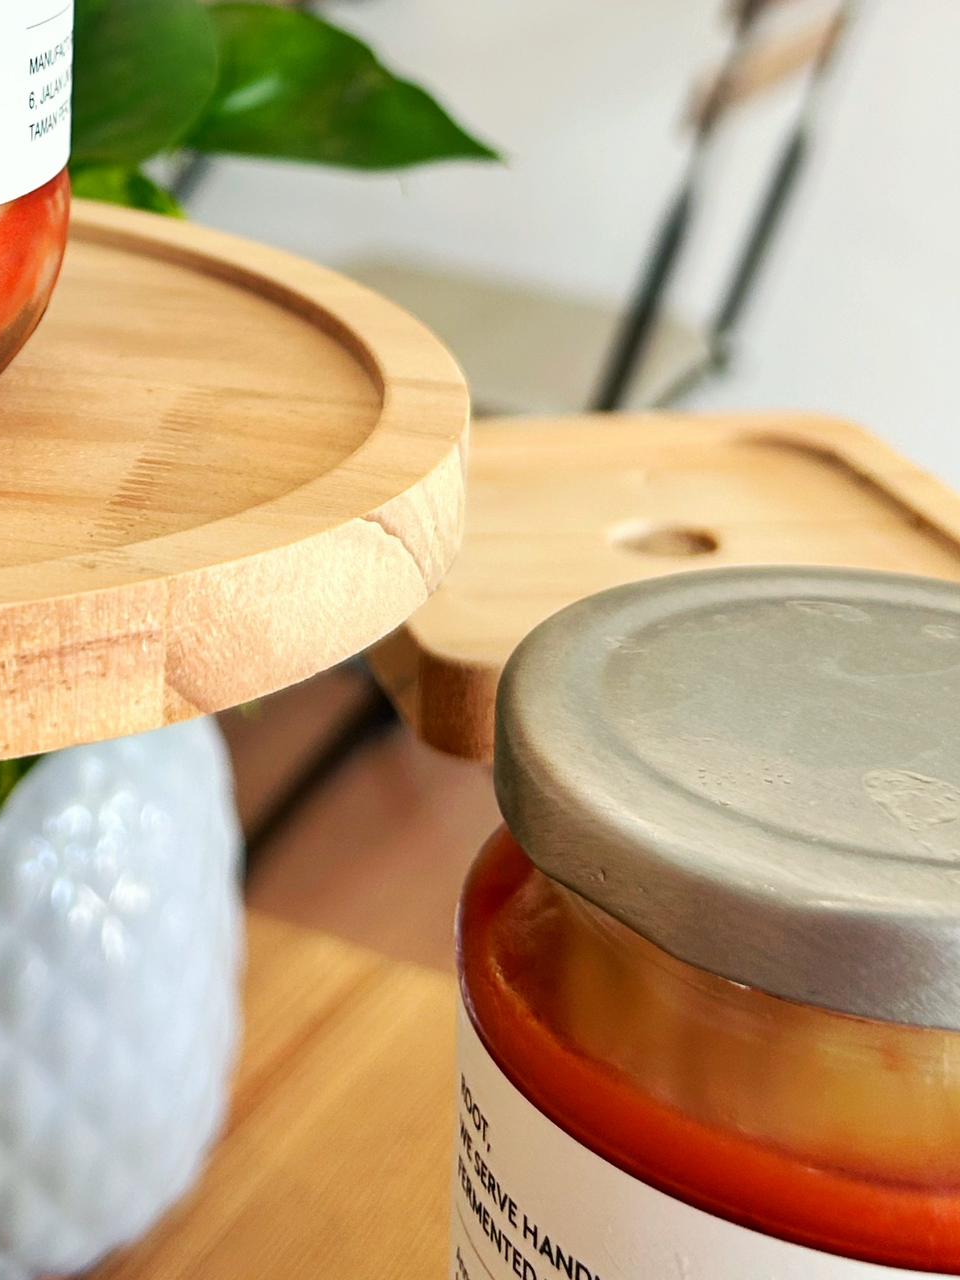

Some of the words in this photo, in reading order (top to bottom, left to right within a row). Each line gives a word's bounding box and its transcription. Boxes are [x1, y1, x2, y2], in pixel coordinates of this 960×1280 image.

[29, 111, 58, 141] TAMAN
[474, 1150, 518, 1229] SERVE
[523, 1214, 602, 1280] HAND
